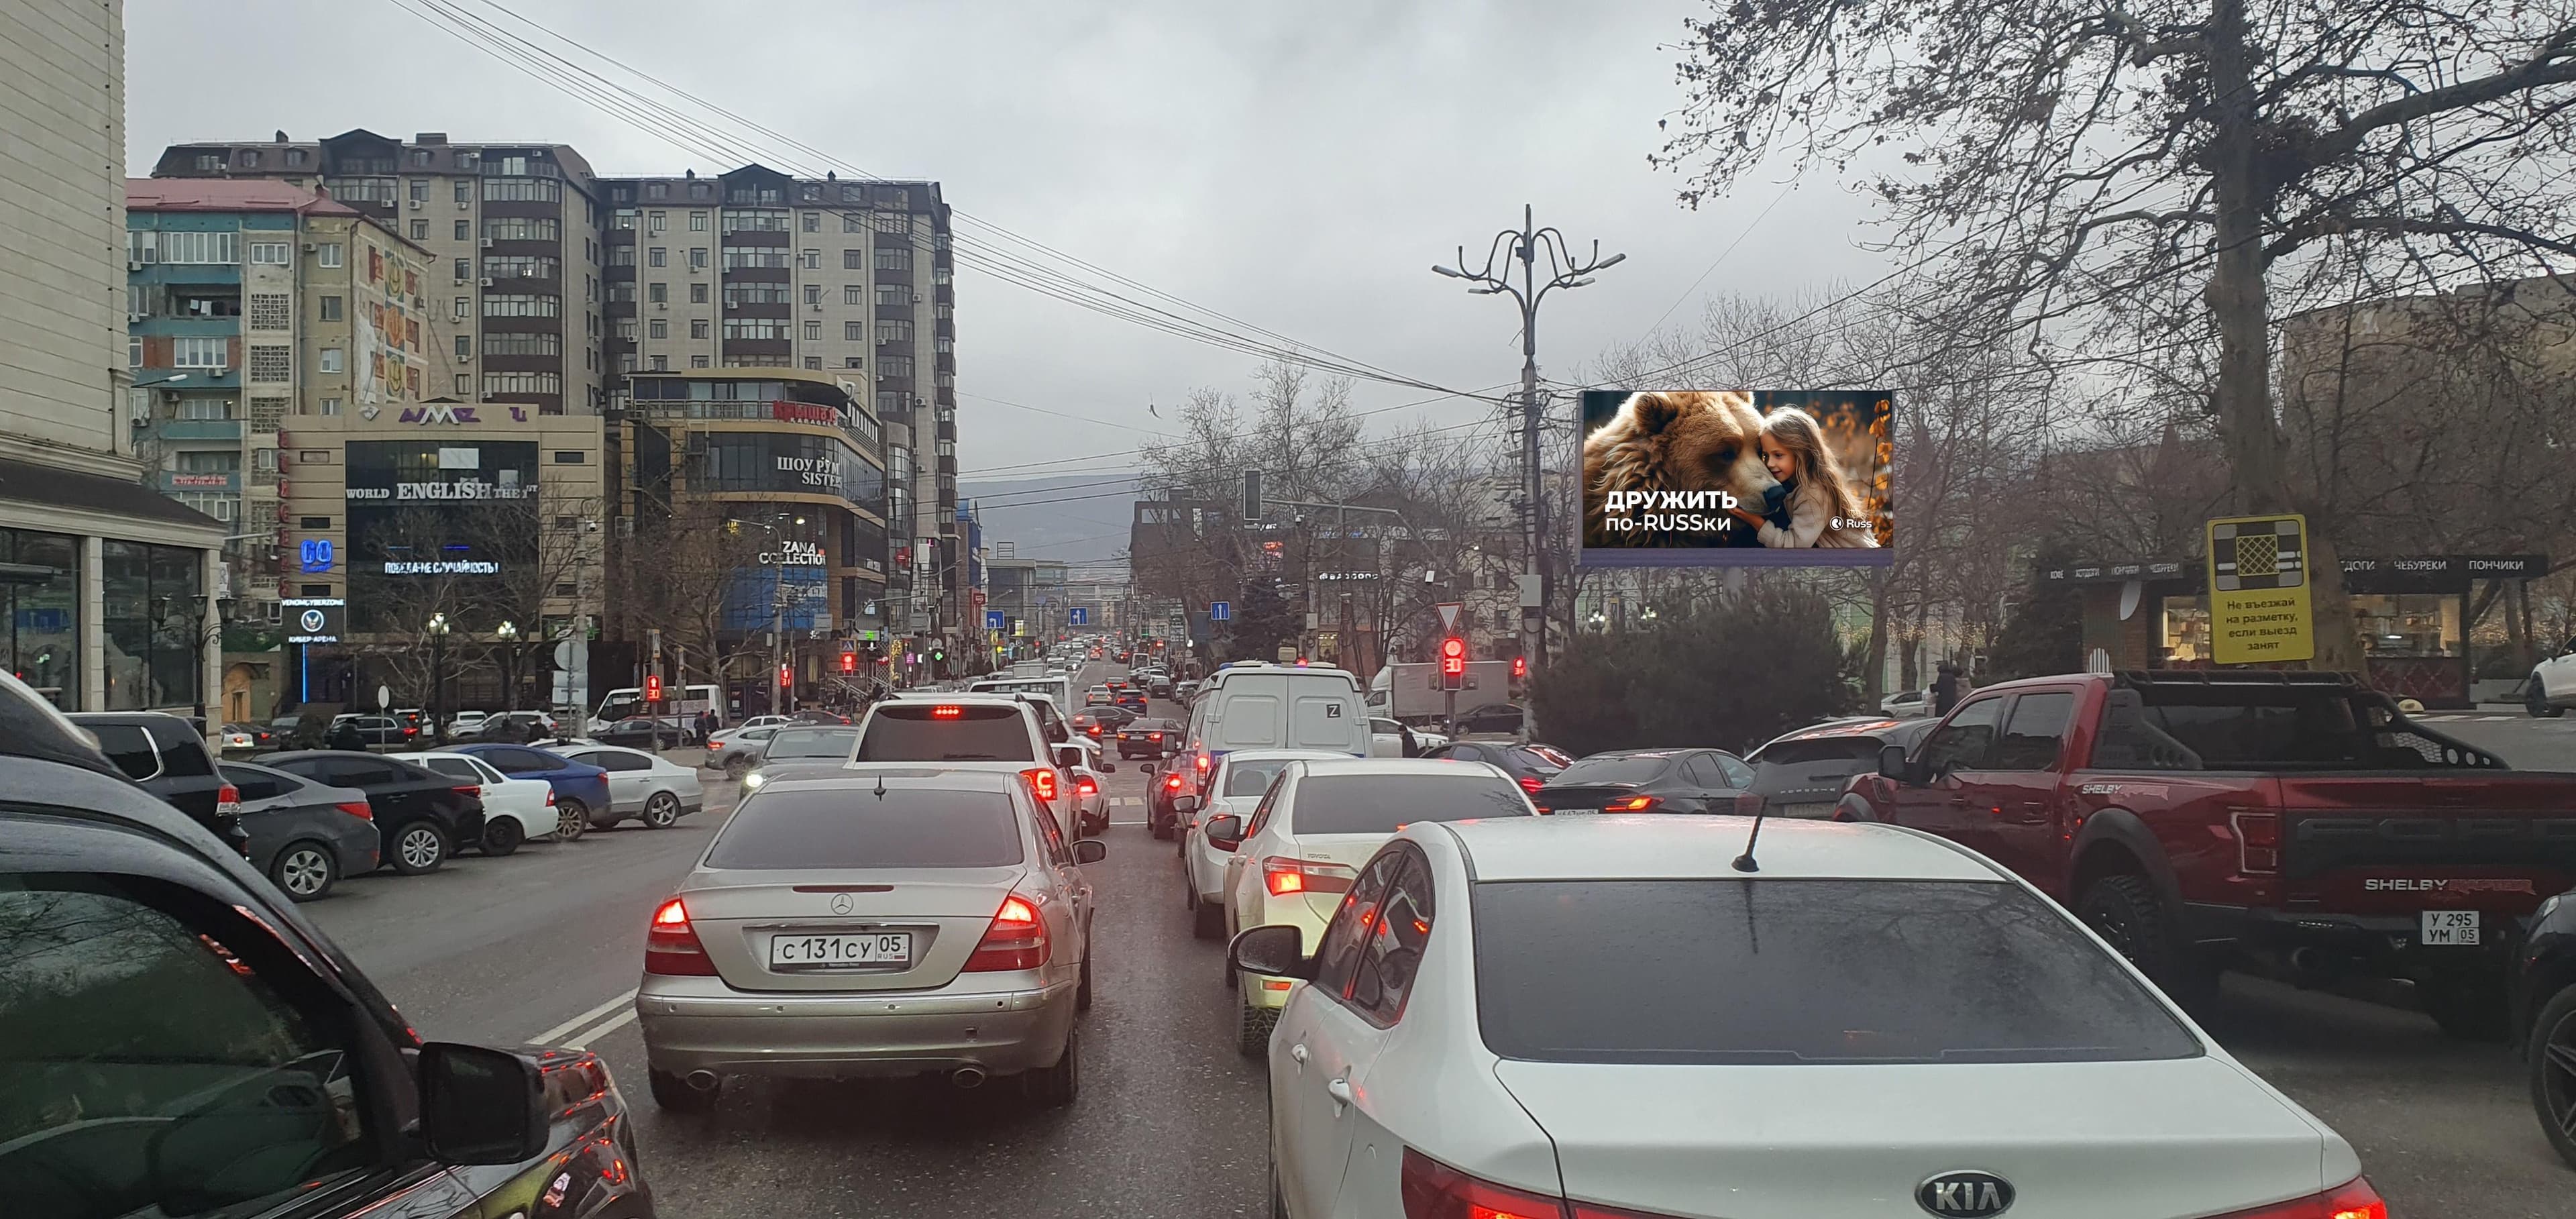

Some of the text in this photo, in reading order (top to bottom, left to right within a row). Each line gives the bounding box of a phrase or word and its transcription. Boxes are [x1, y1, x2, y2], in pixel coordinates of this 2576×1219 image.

[777, 457, 813, 471] ШОУ
[345, 488, 390, 499] WORLD
[396, 482, 492, 500] ENGLISH
[1605, 491, 1738, 512] ДРУЖИТЬ
[1606, 514, 1731, 532] по-RUSSки
[1846, 519, 1872, 529] Russ
[783, 541, 816, 555] ZANA
[759, 552, 826, 566] COLECTIO
[2394, 560, 2447, 571] ЧЕБУРЕКИ
[2469, 560, 2524, 570] ПОНЧИКИ
[2227, 598, 2296, 610] Не въезжай
[2226, 613, 2298, 625] на разметку,
[2229, 627, 2297, 638] если выезд
[2248, 641, 2280, 651] занят
[1446, 658, 1462, 672] 30
[649, 689, 659, 699] 30
[1328, 705, 1340, 717] Z
[2082, 784, 2123, 794] SHELBY
[2365, 879, 2448, 890] SHELBY
[2447, 913, 2472, 926] 295
[2429, 929, 2475, 943] УМ 05
[879, 937, 901, 952] 05
[1934, 1182, 2002, 1210] KIA
